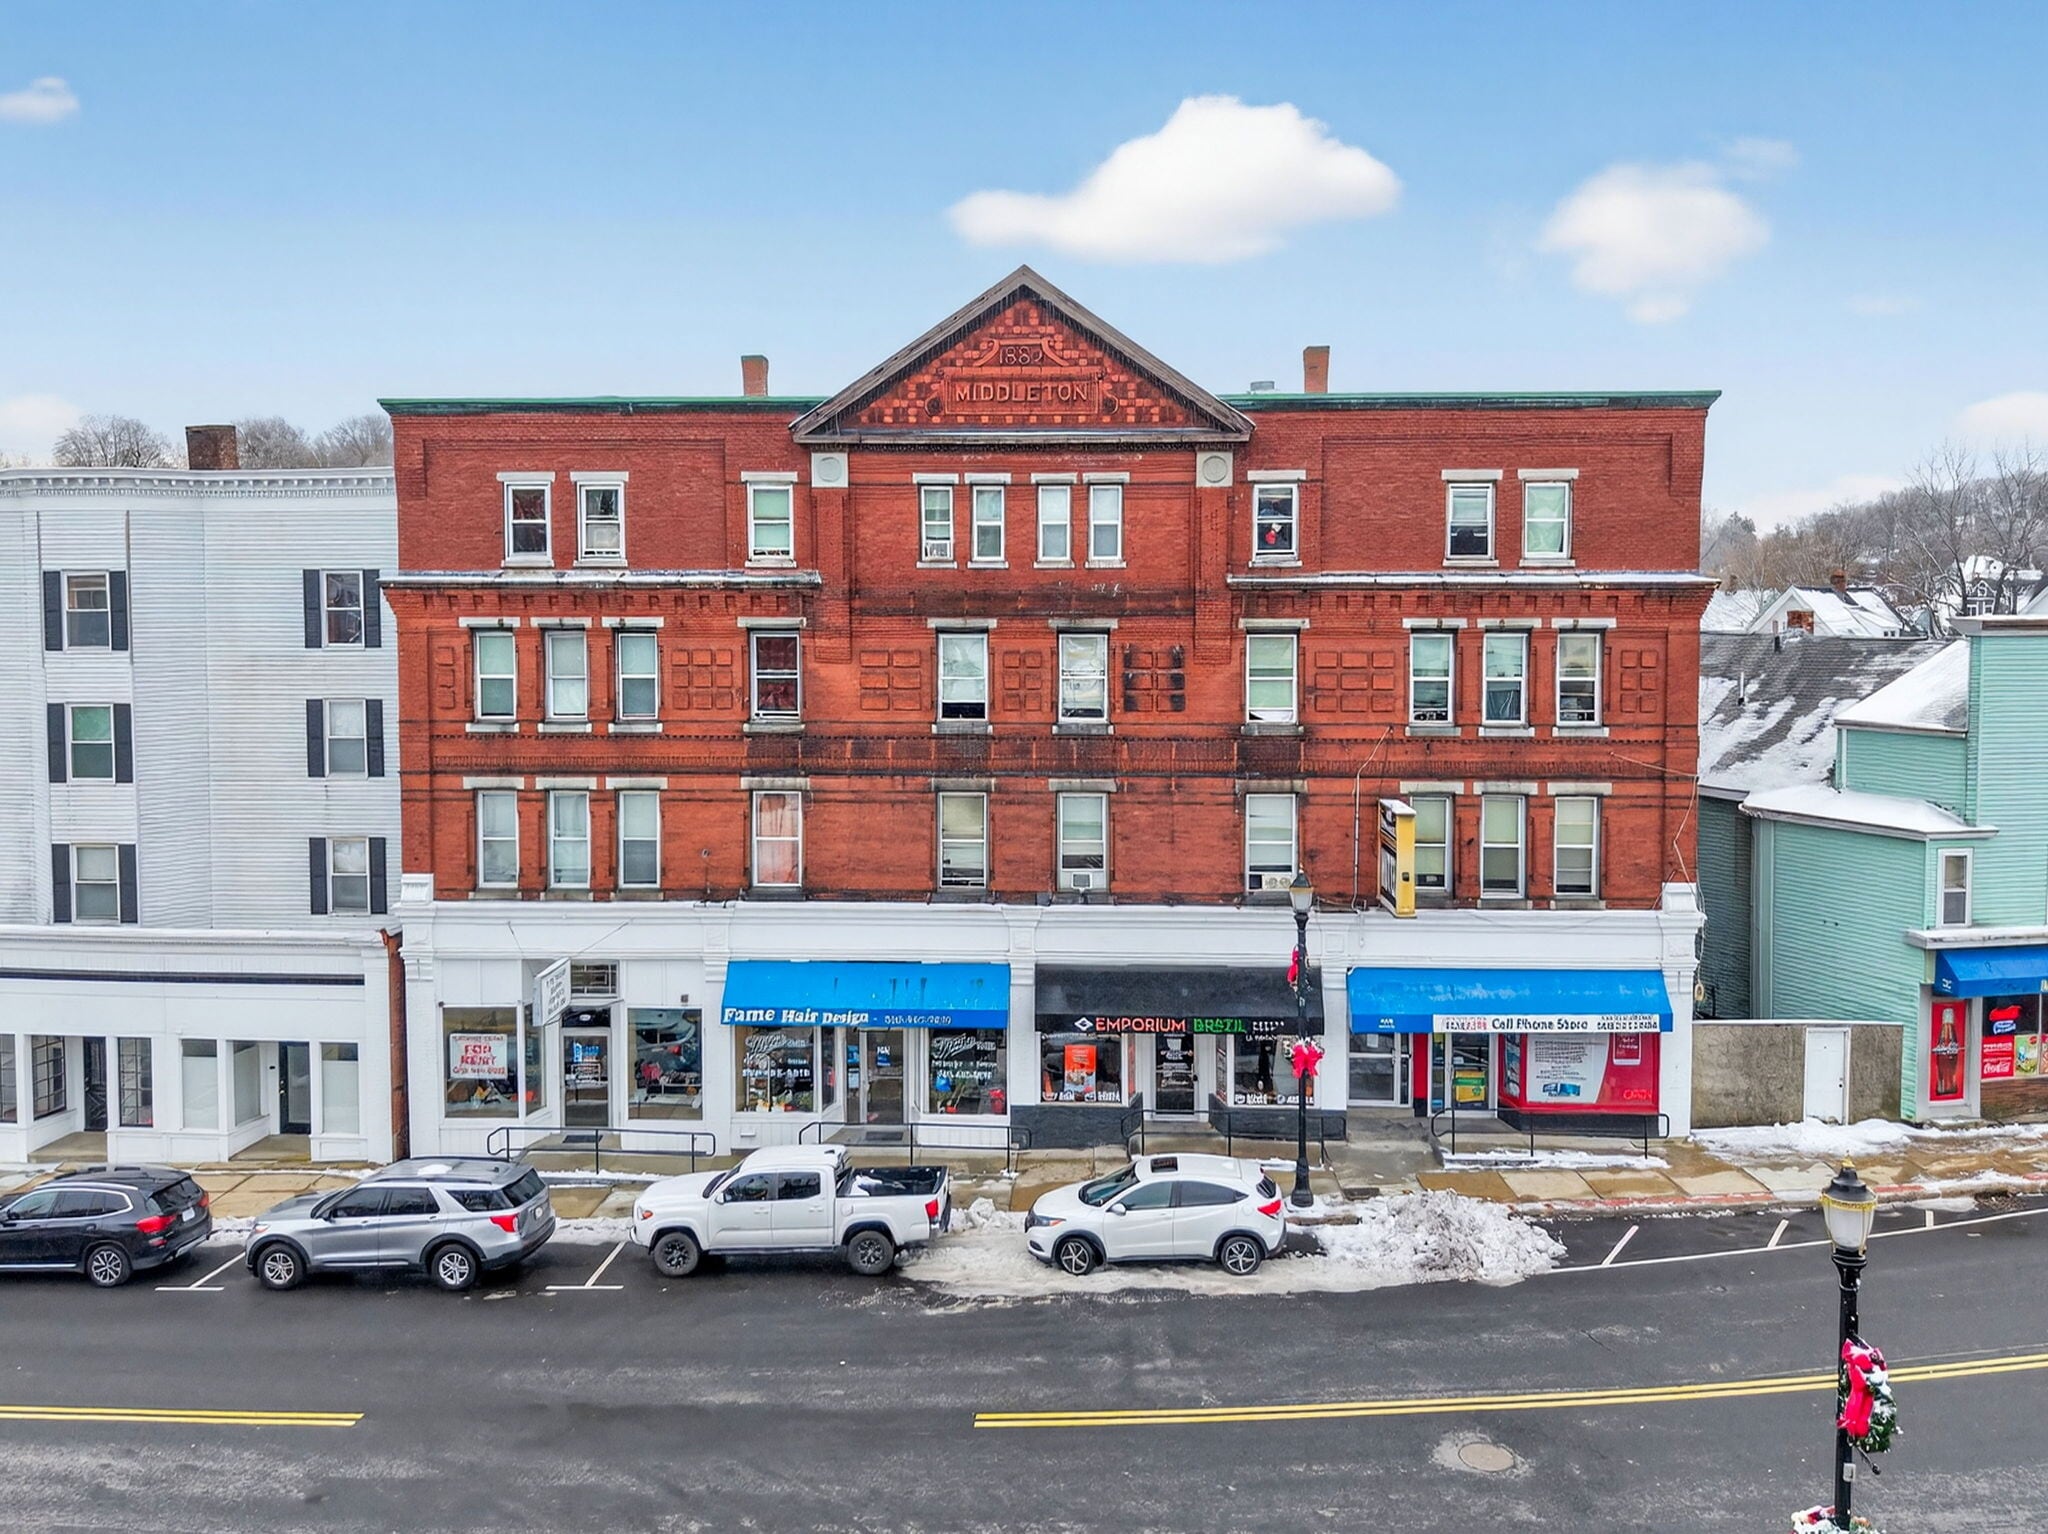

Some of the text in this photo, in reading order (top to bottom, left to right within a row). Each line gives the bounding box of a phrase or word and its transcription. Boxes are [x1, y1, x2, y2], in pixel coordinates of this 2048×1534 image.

[955, 383, 1088, 402] MIDDLETON
[722, 1008, 776, 1023] Fame
[781, 1008, 819, 1023] Hair
[821, 1010, 869, 1025] Design
[1095, 1017, 1186, 1032] EMPORIUM
[1491, 1018, 1514, 1030] Cell
[1516, 1018, 1554, 1030] Phone
[1556, 1018, 1588, 1030] Store
